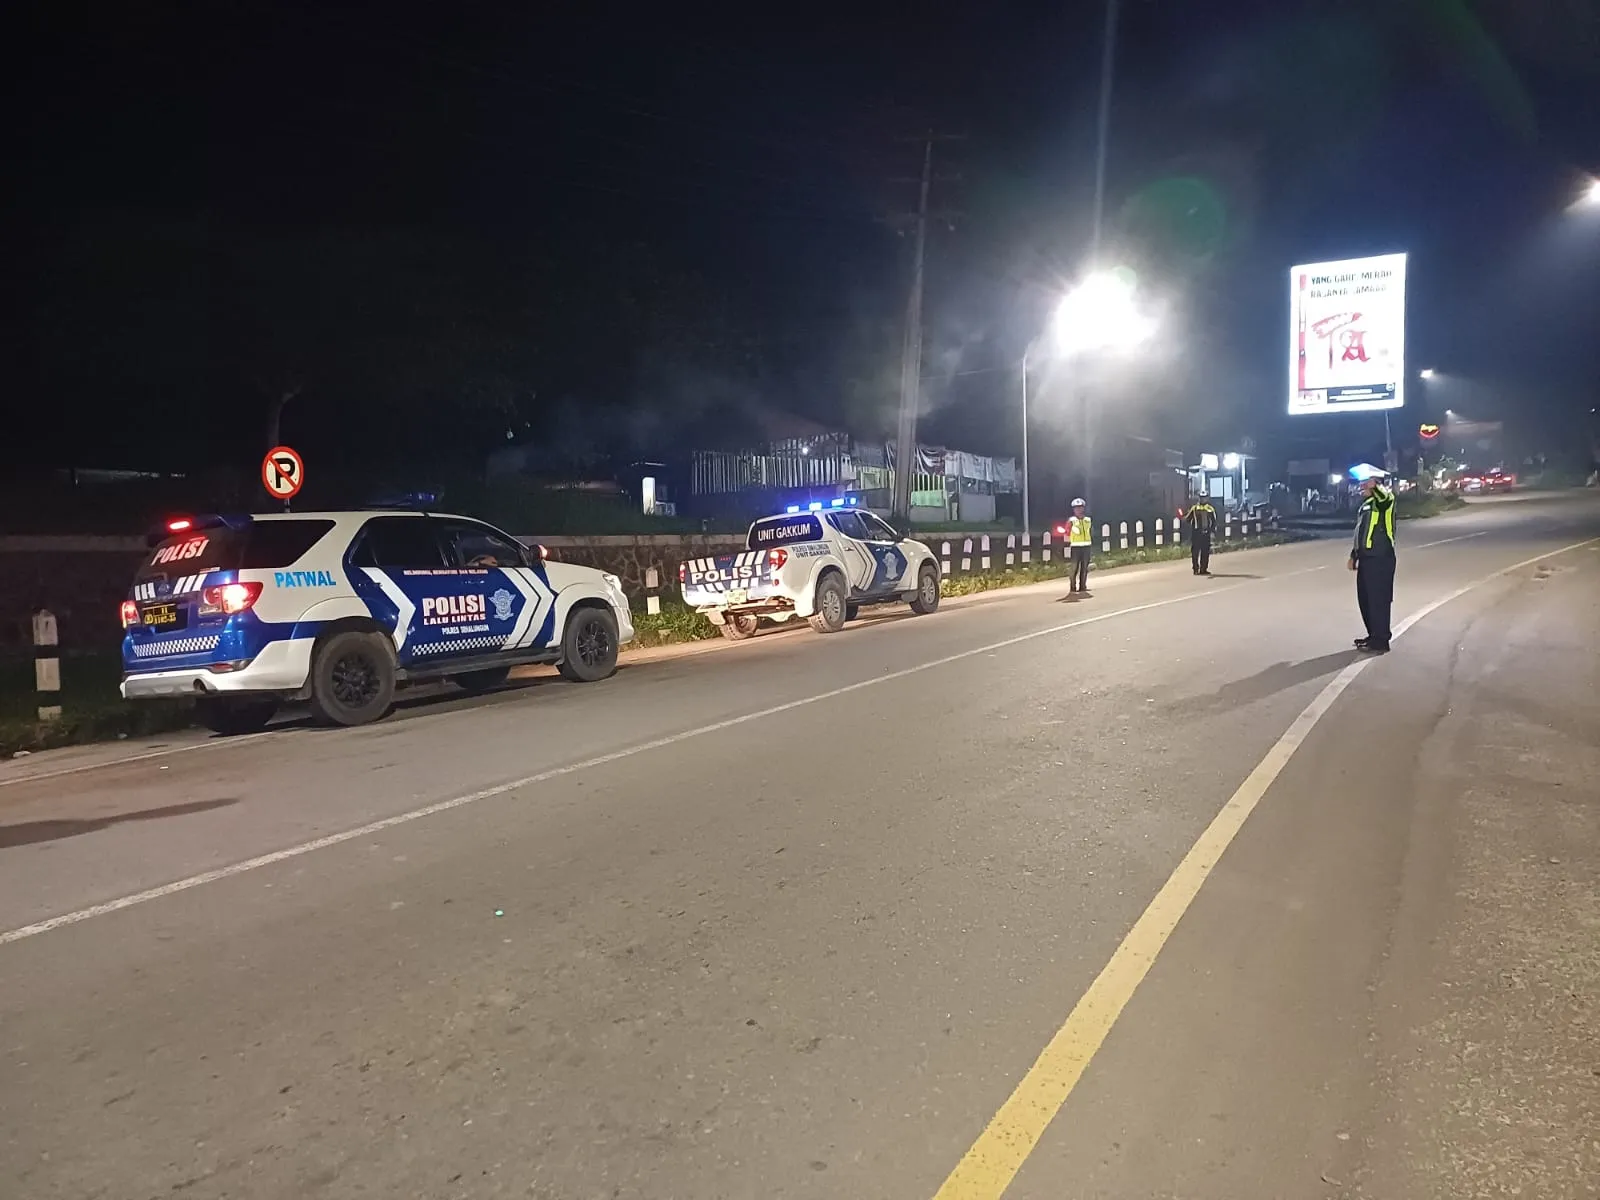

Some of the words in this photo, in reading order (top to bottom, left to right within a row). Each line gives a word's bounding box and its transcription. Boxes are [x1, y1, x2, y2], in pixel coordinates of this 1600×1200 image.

[274, 457, 296, 489] P
[758, 528, 775, 541] UNIT
[776, 523, 811, 539] GAKKUM
[150, 539, 210, 567] POLISI
[274, 571, 337, 588] PATWAL
[692, 564, 763, 585] POLISI
[422, 594, 486, 617] POLISI
[424, 617, 449, 625] LALU
[452, 614, 486, 622] LINTAS
